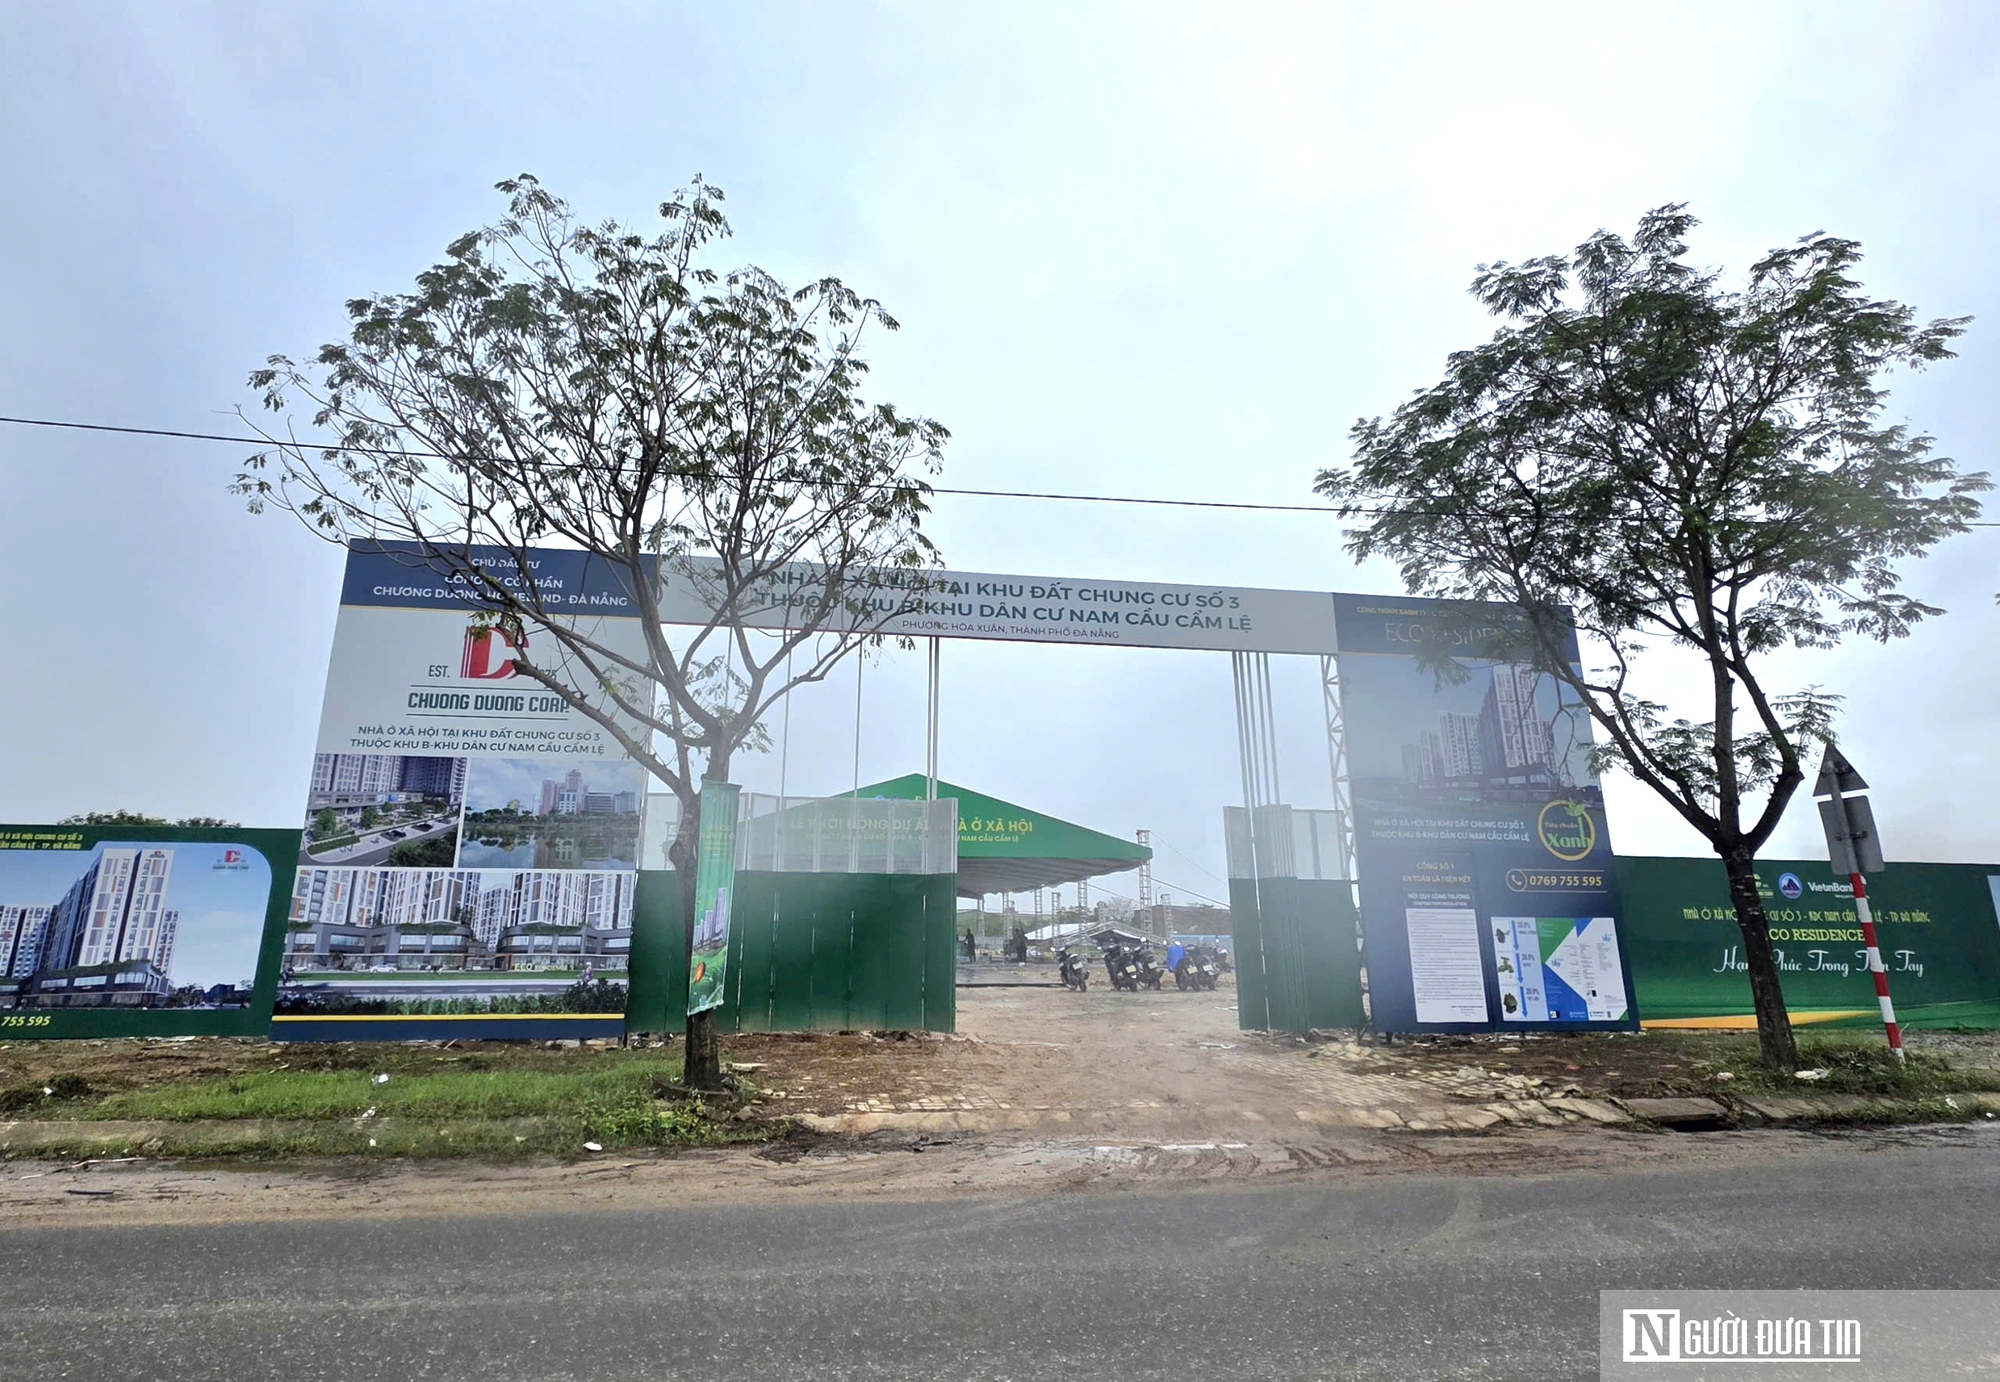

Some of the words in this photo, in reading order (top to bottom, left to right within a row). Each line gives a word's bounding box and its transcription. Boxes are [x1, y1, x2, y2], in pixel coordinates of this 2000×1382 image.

[525, 576, 563, 589] HẦN
[373, 585, 432, 598] CHƯƠNG
[568, 593, 587, 605] ĐÀ
[590, 592, 628, 606] NẴNG
[976, 582, 1023, 598] KHU
[1029, 581, 1073, 600] ĐẤT
[1078, 588, 1155, 604] CHUNG
[1160, 592, 1191, 606] CƯ
[1195, 590, 1224, 608] SỐ
[1228, 596, 1240, 609] 3
[757, 591, 837, 612] THUỘ
[845, 597, 894, 612] KHU
[980, 601, 1027, 620] DÂN
[1033, 607, 1065, 621] CƯ
[1070, 609, 1119, 624] NAM
[1125, 607, 1169, 626] CẦU
[1175, 609, 1222, 630] CẨM
[1229, 614, 1252, 634] LỆ
[902, 620, 948, 630] PHƯỜNG
[951, 622, 974, 632] HÒA
[977, 623, 1007, 635] XUÂN,
[1010, 624, 1046, 636] THÀNH
[1048, 626, 1071, 637] PHỐ
[1073, 627, 1088, 637] ĐÀ
[1090, 628, 1119, 639] NẴNG
[1385, 622, 1425, 643] ECO
[428, 665, 450, 678] EST.
[408, 692, 470, 710] CHUONG
[474, 695, 524, 712] DUONG
[528, 696, 570, 713] CORP.
[358, 724, 384, 735] NHÀ
[387, 724, 396, 735] Ở
[398, 725, 415, 736] XÃ
[418, 725, 439, 737] HỘI
[441, 728, 459, 739] TẠI
[462, 729, 487, 738] KHU
[490, 727, 513, 739] ĐẤT
[514, 730, 555, 740] CHUNG
[558, 731, 575, 741] CƯ
[576, 730, 592, 741] SỐ
[594, 732, 600, 741] 3
[350, 737, 391, 749] THUỘC
[393, 740, 419, 749] KHU
[422, 740, 459, 750] B-KHU
[462, 740, 487, 751] DÂN
[490, 742, 506, 751] CƯ
[508, 743, 535, 752] NAM
[591, 743, 605, 755] LỆ
[971, 816, 982, 832] Ở
[986, 818, 1005, 832] XÃ
[1008, 818, 1033, 836] HỘI
[1546, 816, 1591, 848] Xanh
[1529, 875, 1557, 886] 0769
[1559, 876, 1579, 887] 755
[1582, 876, 1602, 887] 595
[1683, 907, 1699, 920] NHÀ
[1701, 906, 1711, 920] Ở
[1725, 907, 1738, 921] HỘ
[1796, 910, 1802, 922] 3
[1824, 911, 1840, 923] NAM
[1768, 928, 1790, 941] CO
[1791, 928, 1866, 942] RESIDENCE
[1807, 949, 1849, 978] Trong
[1894, 949, 1924, 978] Tay
[1, 1016, 26, 1026] 755
[26, 1016, 51, 1026] 595
